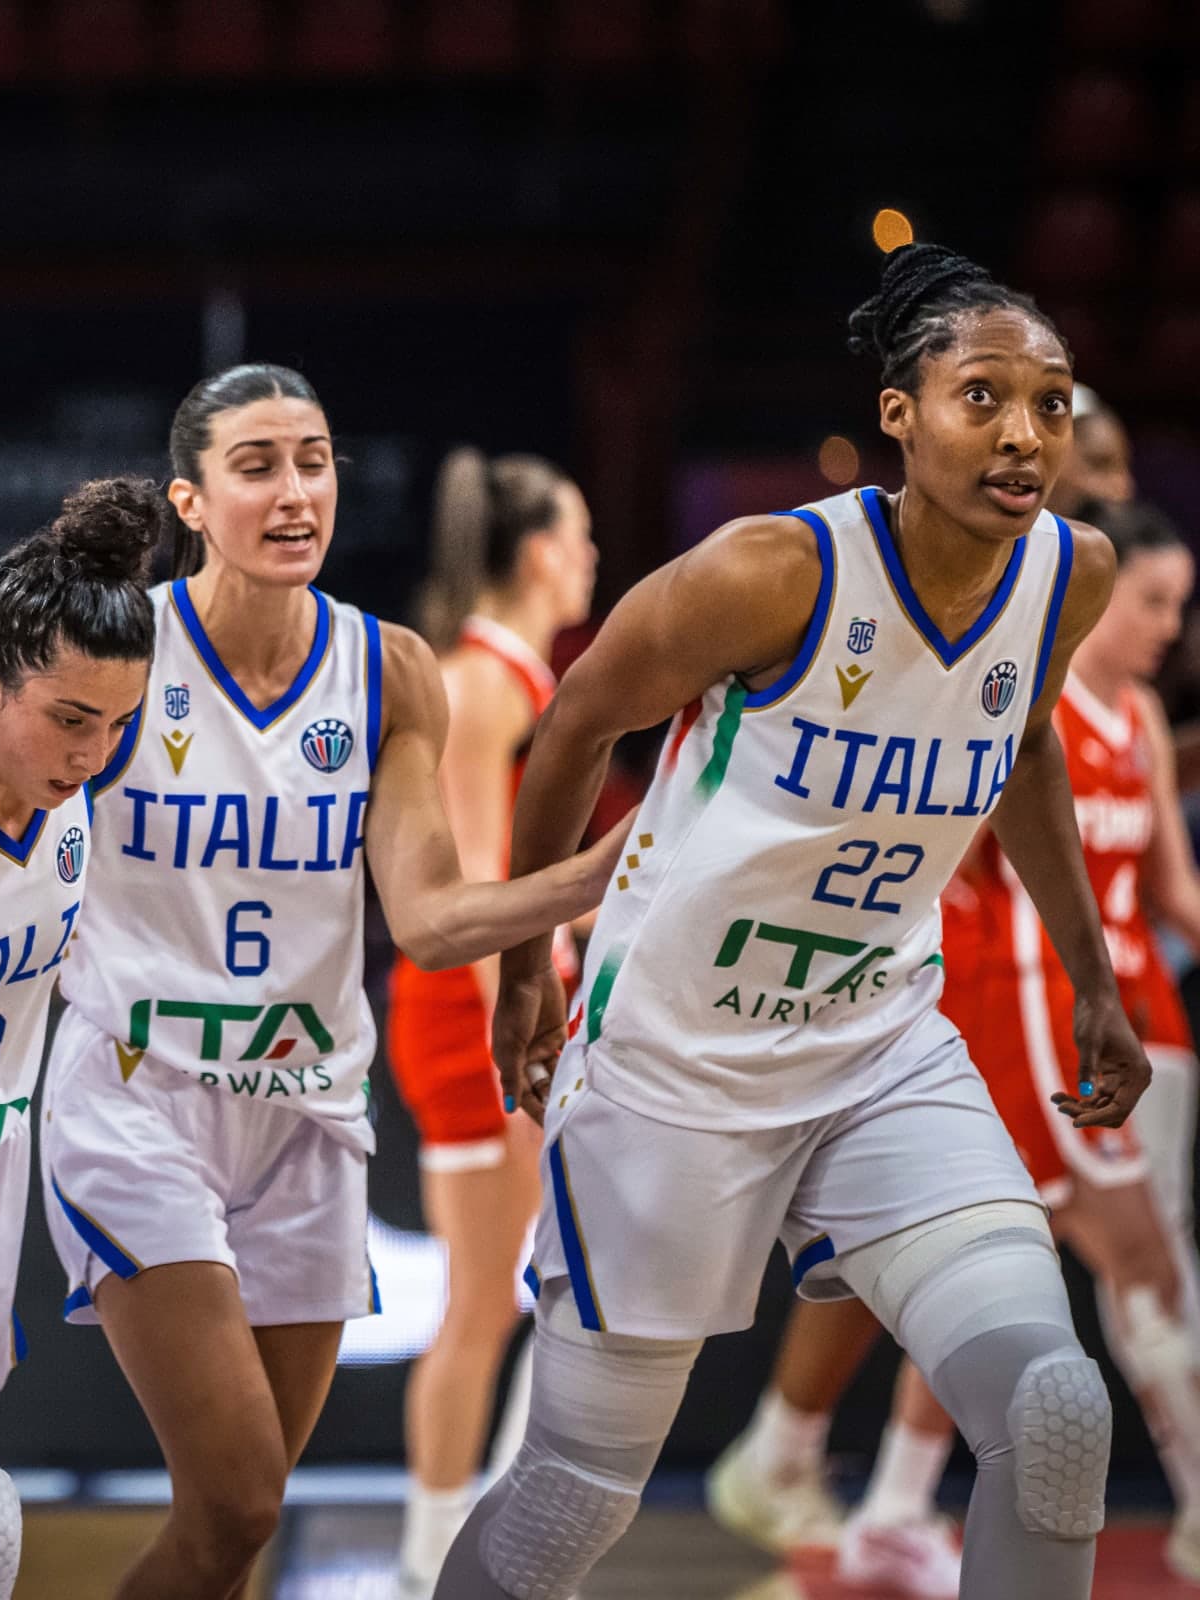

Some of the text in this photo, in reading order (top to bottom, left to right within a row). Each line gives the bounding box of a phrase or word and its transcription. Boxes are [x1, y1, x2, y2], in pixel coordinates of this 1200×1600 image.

[121, 787, 369, 872] ITALIA
[812, 840, 924, 914] 22
[225, 901, 272, 977] 6
[129, 999, 335, 1061] ITA
[712, 970, 888, 1025] AIRYS
